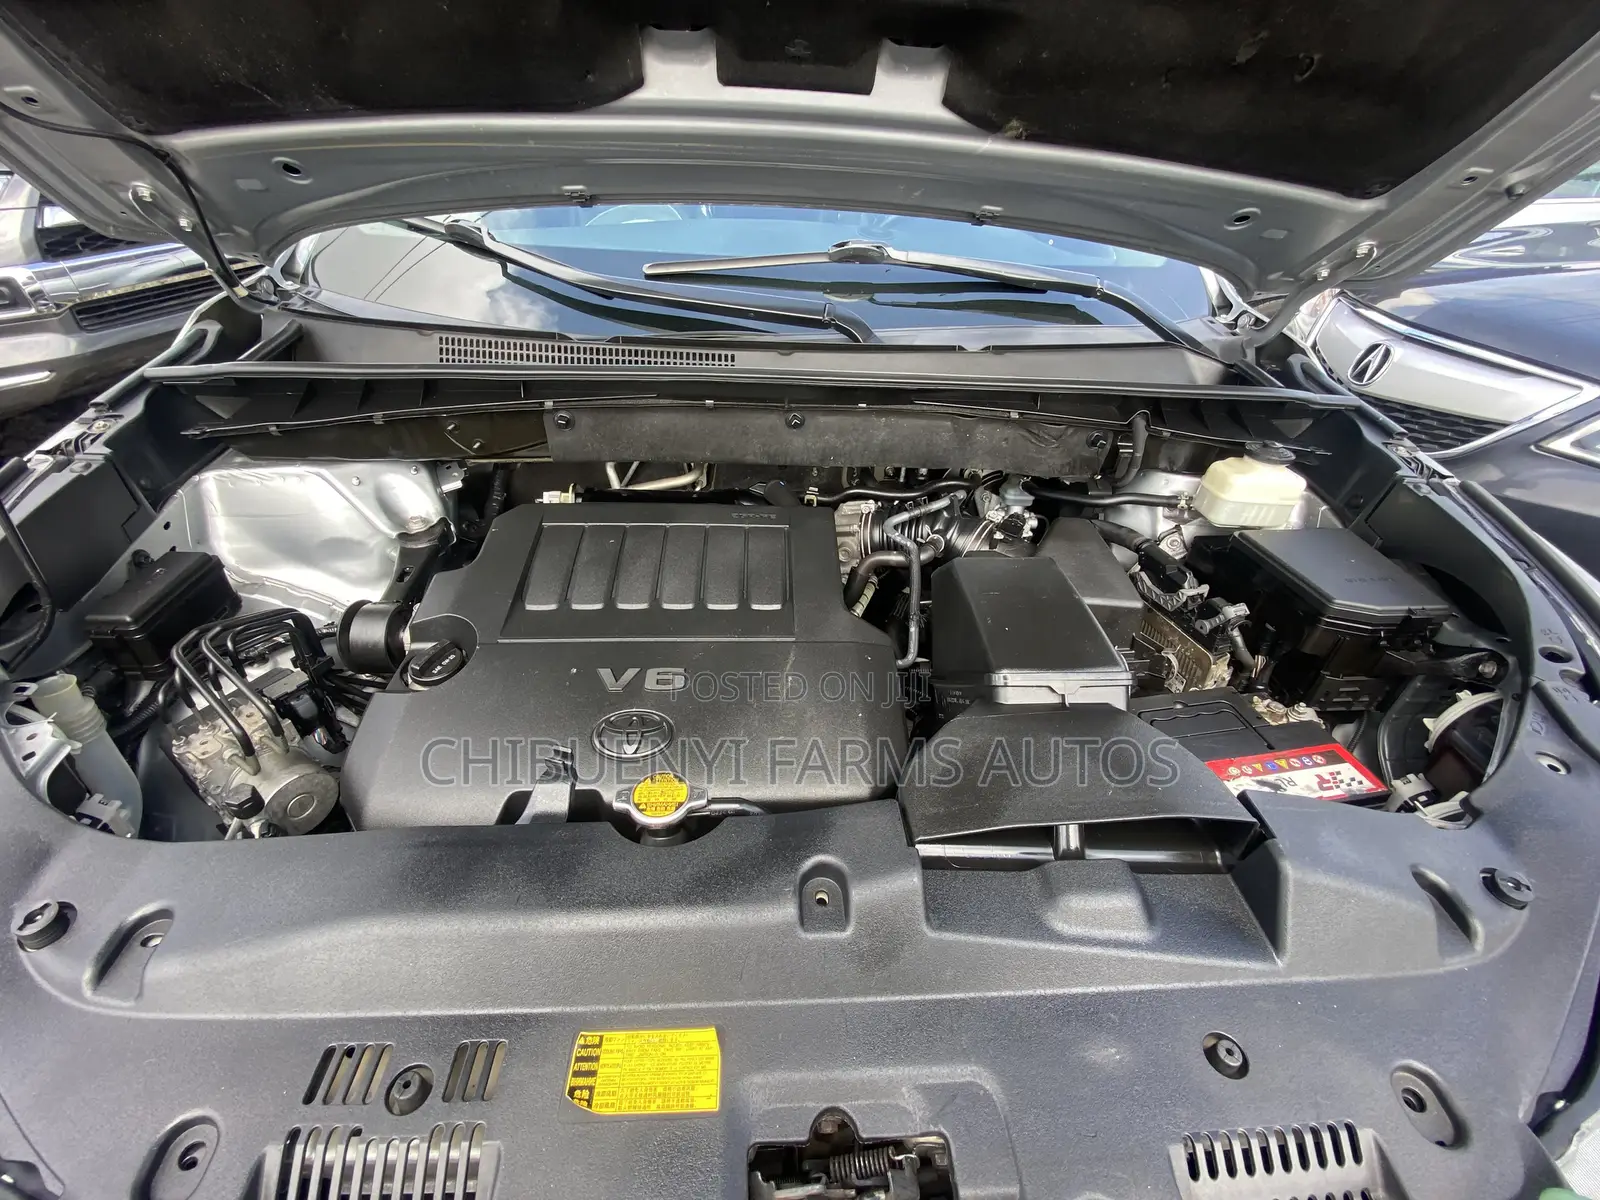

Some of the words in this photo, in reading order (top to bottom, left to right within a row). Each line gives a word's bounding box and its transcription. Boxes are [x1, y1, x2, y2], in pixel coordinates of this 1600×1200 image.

[597, 667, 686, 692] V6
[576, 1048, 601, 1057] CAUTION
[573, 1062, 598, 1071] ATTENTION
